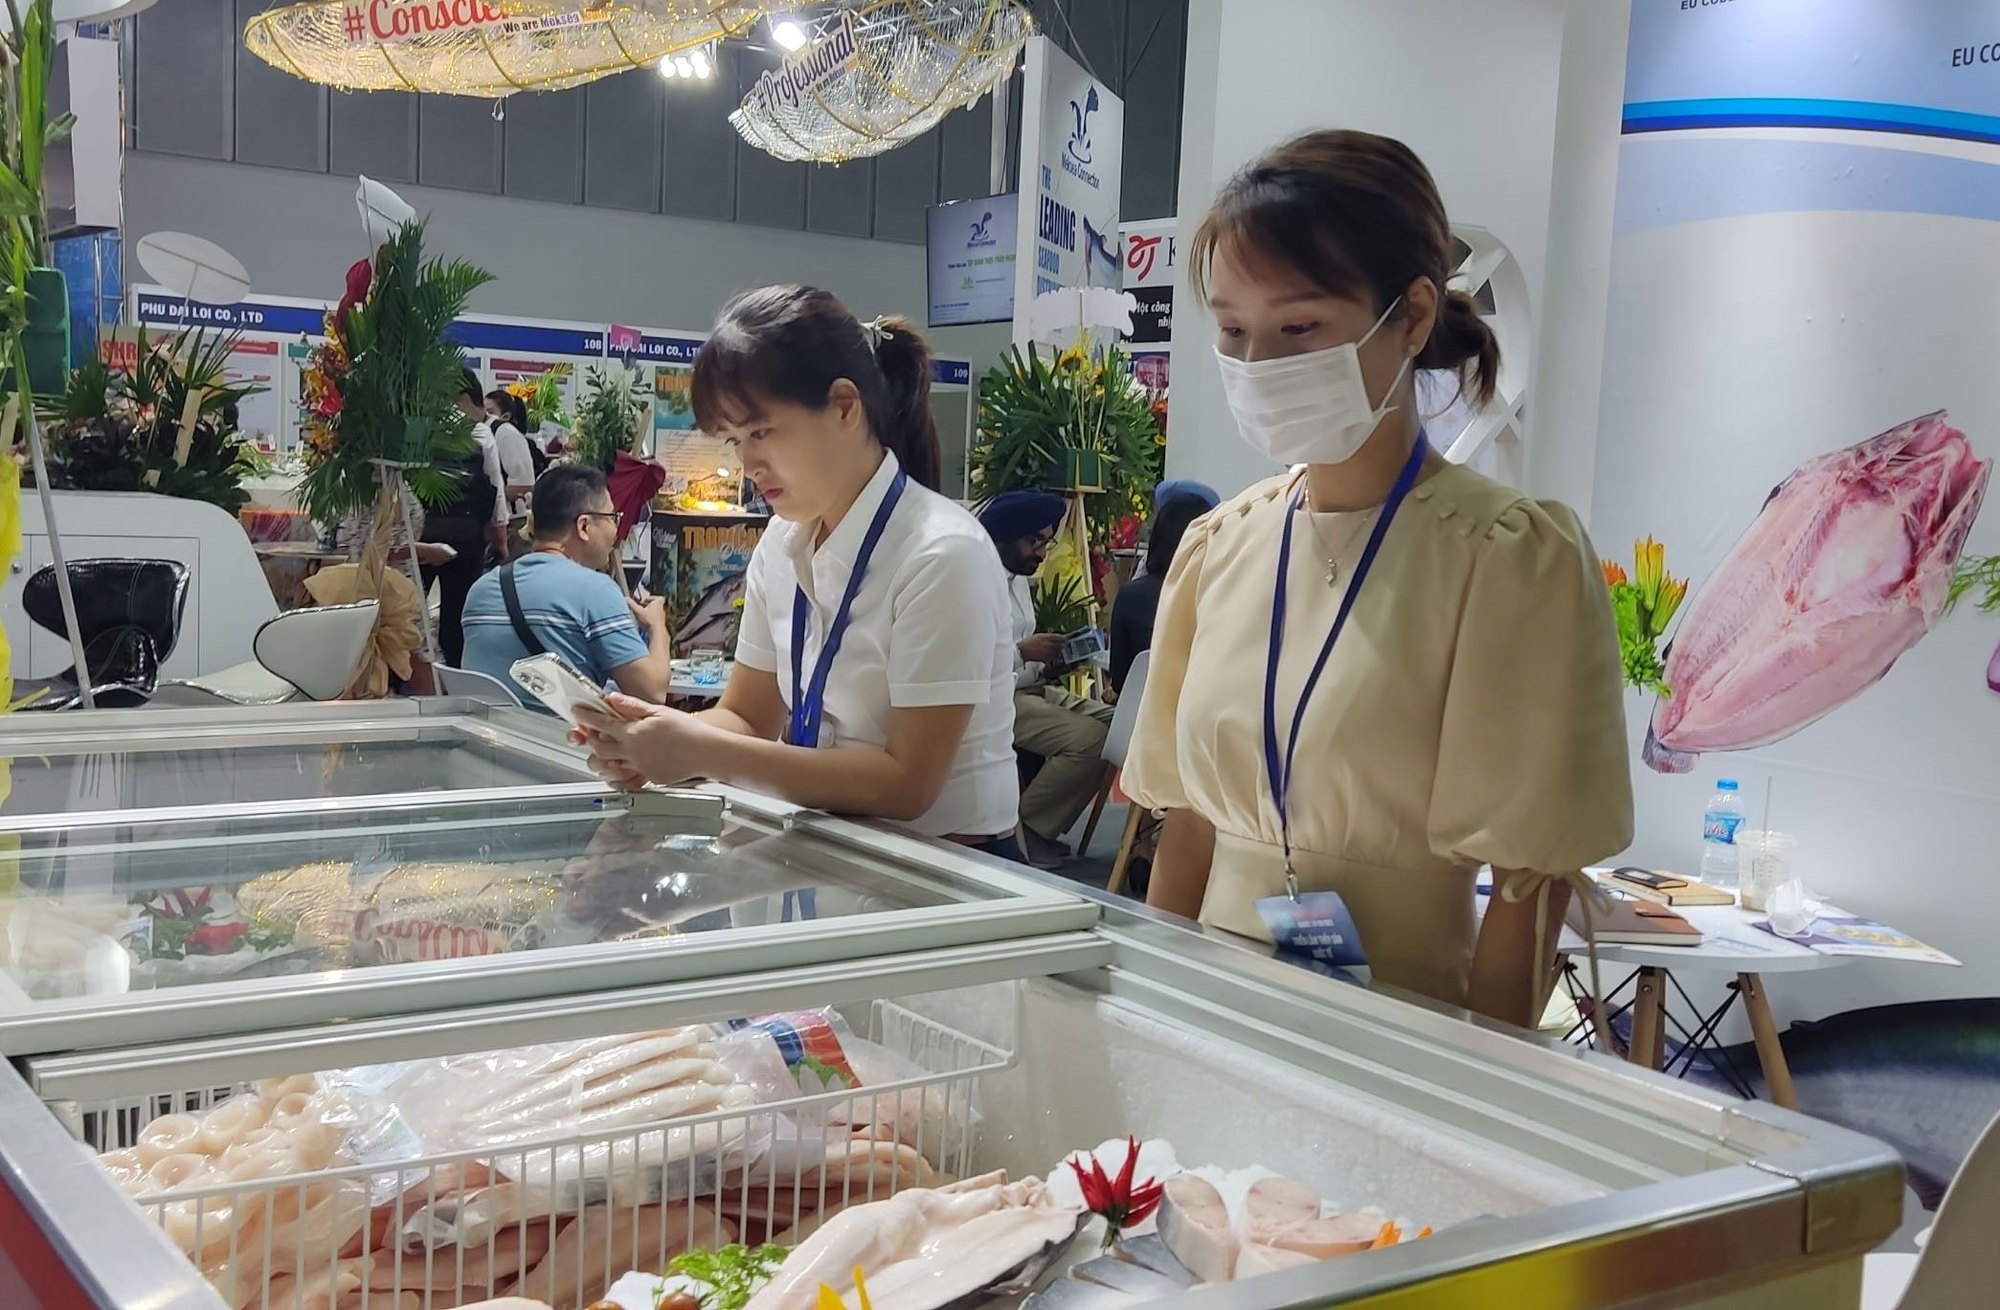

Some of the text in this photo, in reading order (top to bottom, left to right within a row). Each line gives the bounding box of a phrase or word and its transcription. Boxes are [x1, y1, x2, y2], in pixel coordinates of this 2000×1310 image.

[1681, 0, 1697, 10] EU
[344, 0, 508, 41] #Conscie
[522, 20, 538, 31] are
[1952, 46, 1974, 68] EU
[1041, 164, 1051, 190] THE
[1039, 193, 1076, 253] LEADING
[141, 302, 165, 316] PHU
[169, 304, 189, 318] DAI
[192, 306, 211, 320] LOI
[240, 310, 264, 324] LTD
[584, 338, 602, 350] 108
[649, 343, 664, 355] LOI
